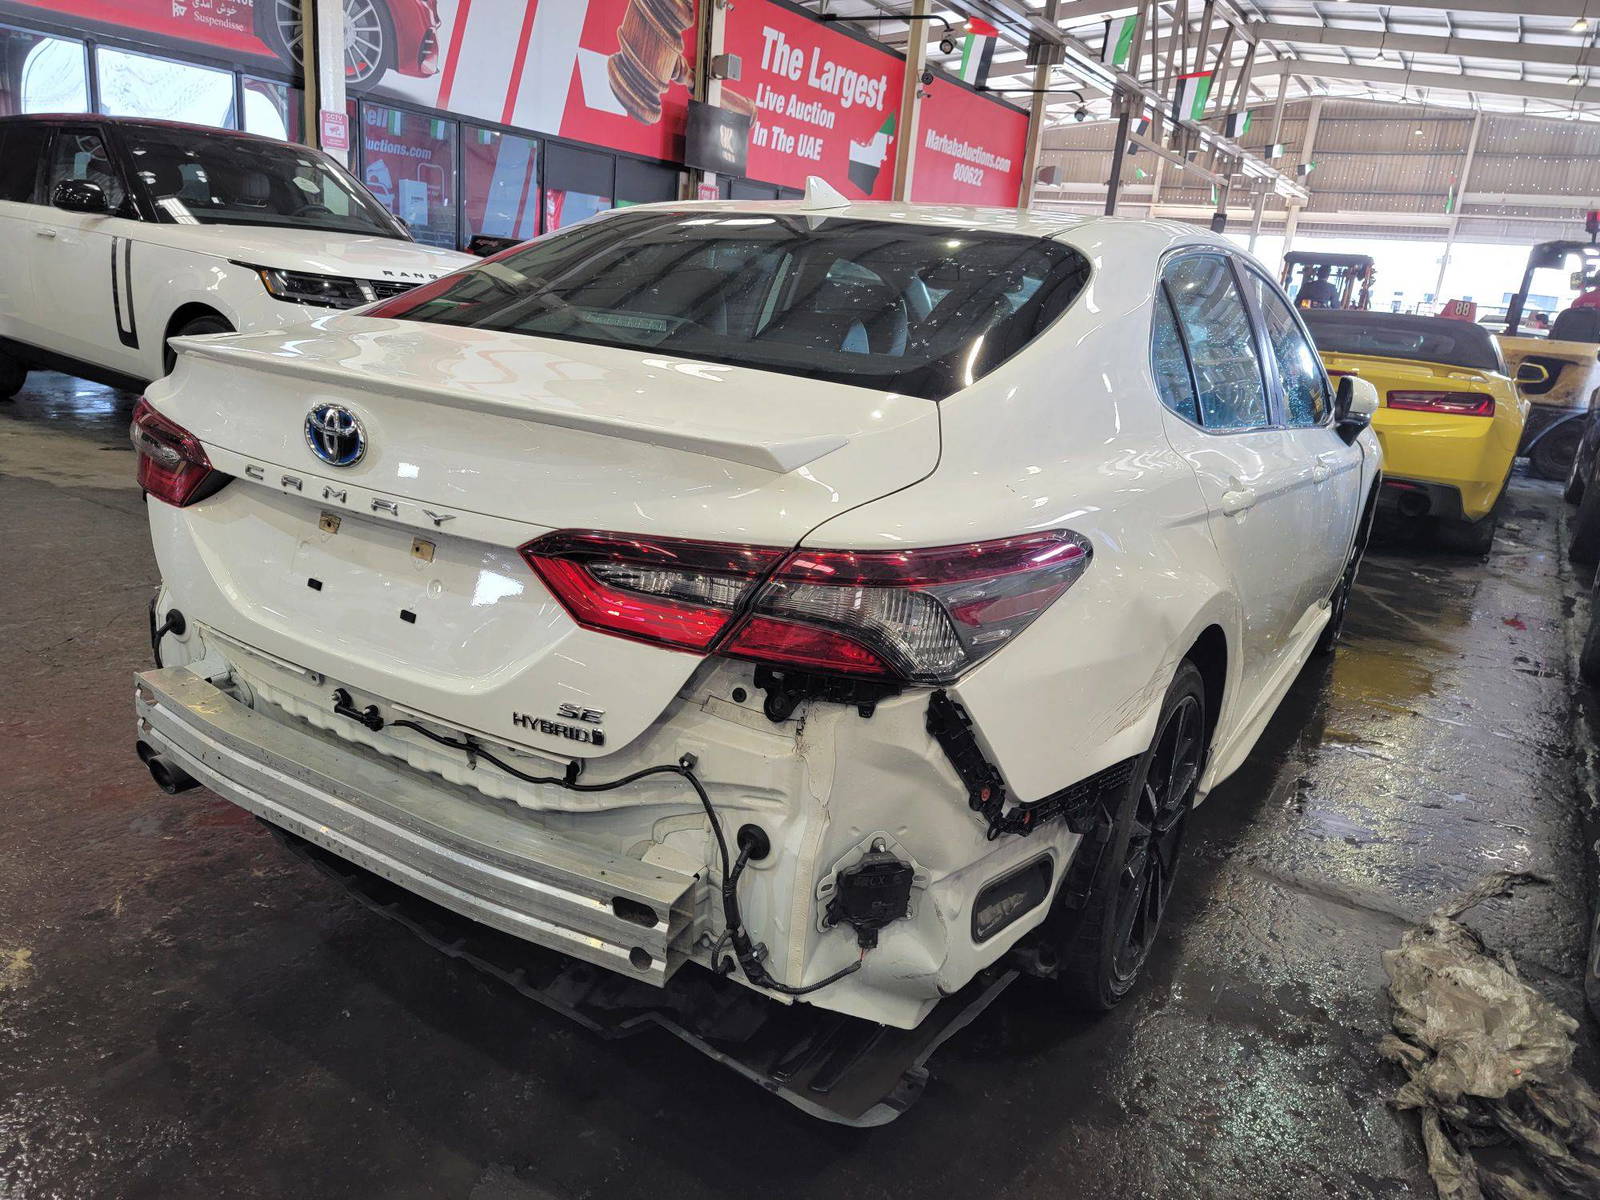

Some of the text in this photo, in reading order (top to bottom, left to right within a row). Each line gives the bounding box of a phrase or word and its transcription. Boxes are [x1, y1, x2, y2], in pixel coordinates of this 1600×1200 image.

[193, 11, 245, 32] Suspendisse
[761, 25, 887, 112] The Largest
[755, 82, 836, 129] Live Auction
[752, 121, 768, 147] In
[771, 126, 795, 154] The
[797, 133, 824, 161] UAE
[925, 128, 1011, 173] MarhabaAuctions.com
[953, 162, 984, 187] 800622
[382, 270, 439, 280] RANG
[245, 463, 457, 527] CAMRY
[512, 711, 590, 743] HYBRID
[556, 702, 606, 724] SE
